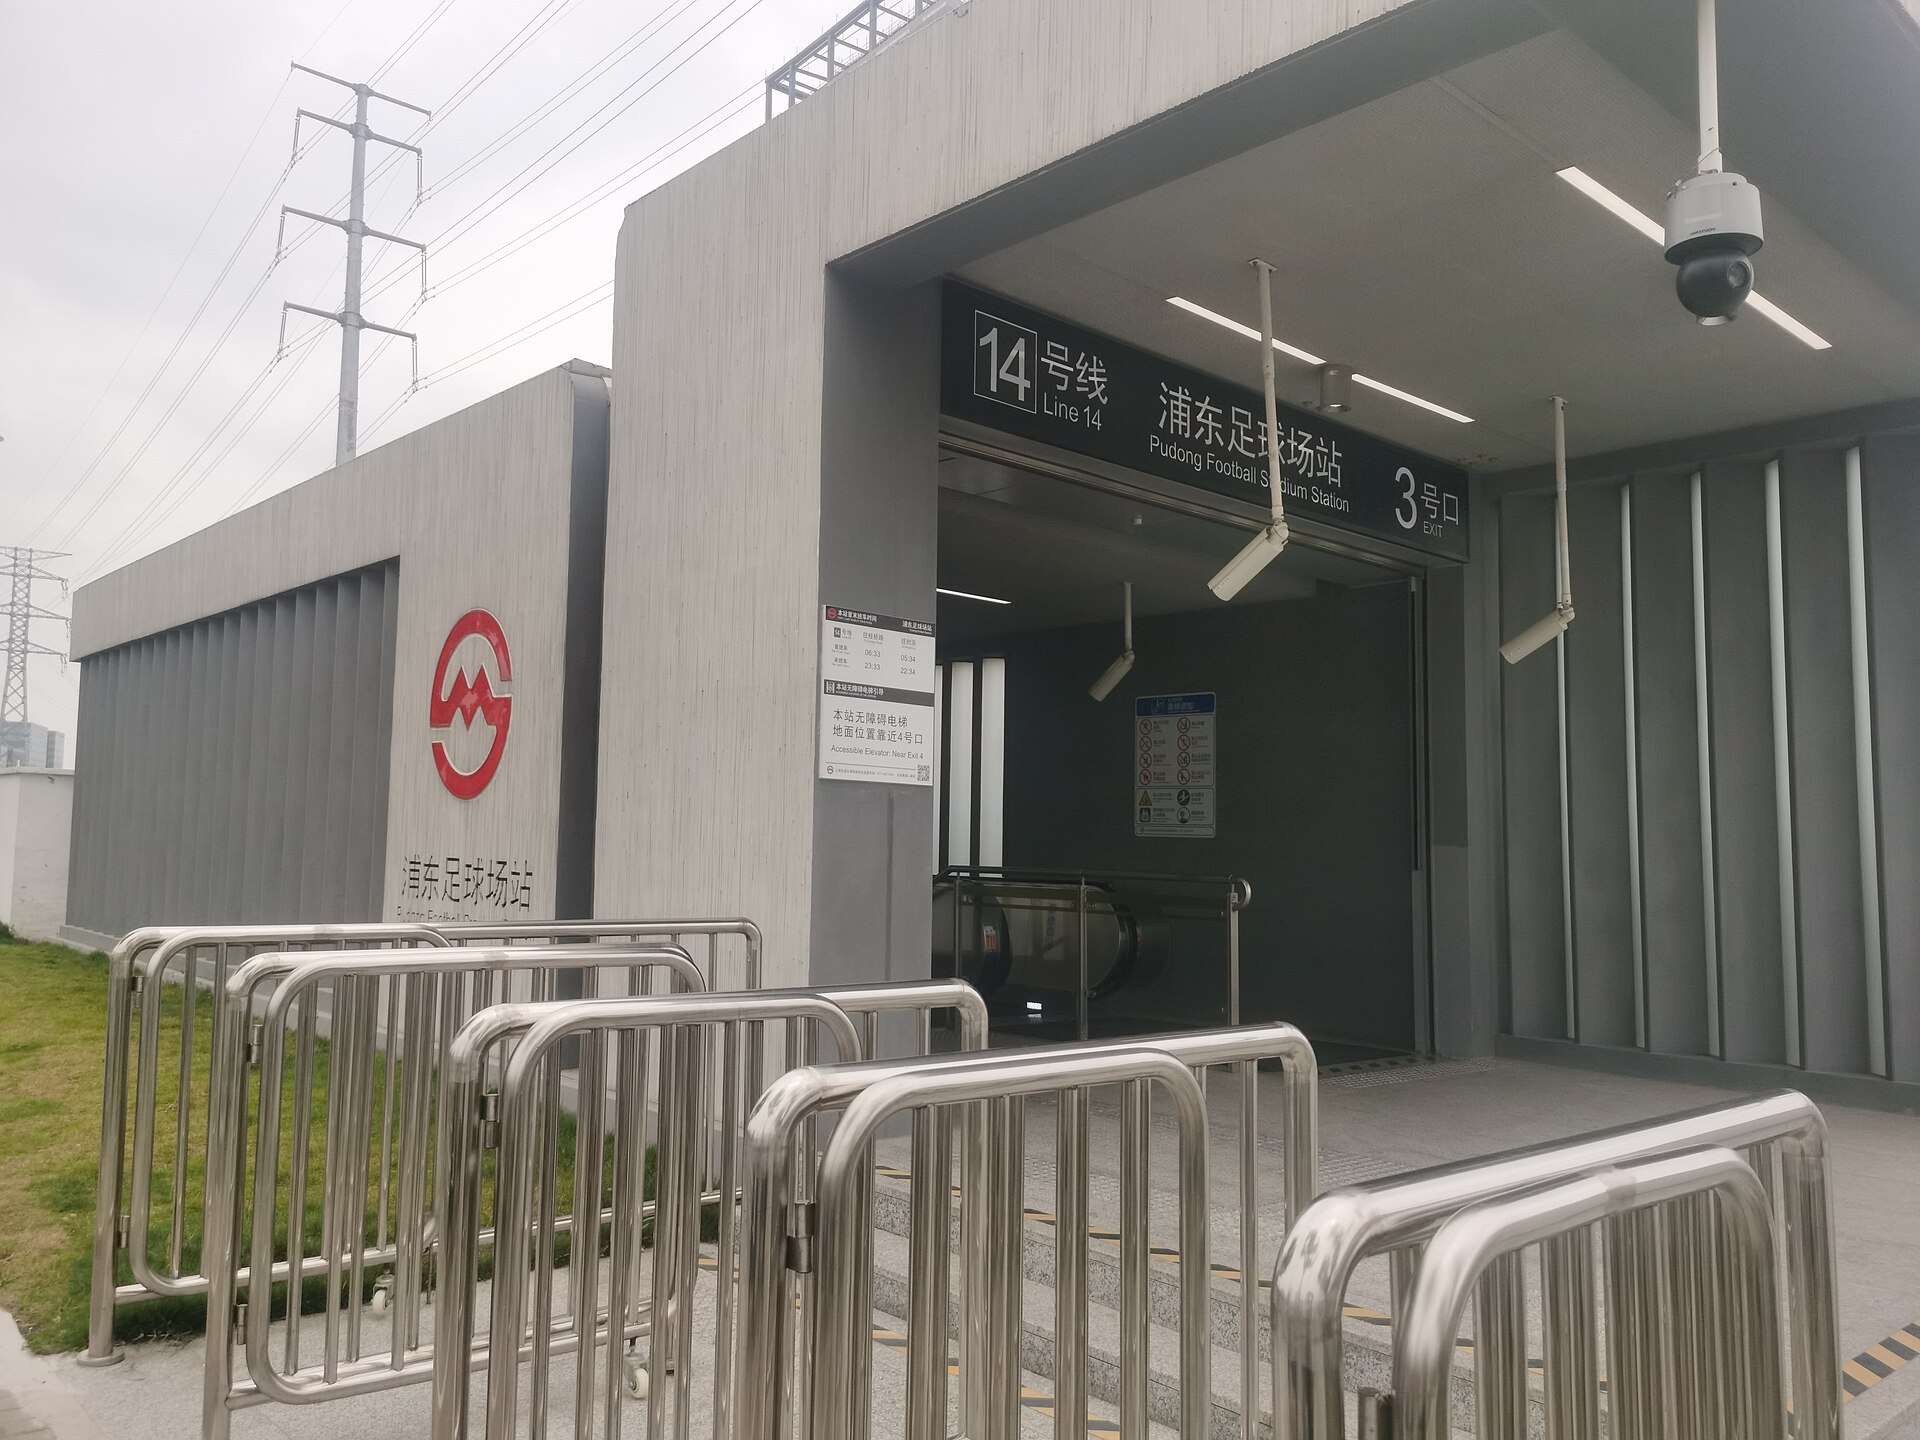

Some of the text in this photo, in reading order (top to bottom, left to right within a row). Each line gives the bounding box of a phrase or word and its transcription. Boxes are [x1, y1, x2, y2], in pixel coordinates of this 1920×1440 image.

[979, 327, 1108, 405] 14 号线
[1043, 392, 1102, 431] Line 14
[1158, 381, 1342, 488] 浦东足球场站
[1149, 433, 1350, 513] Pudong Football Sdium Station
[1423, 520, 1444, 538] EXIT
[864, 649, 881, 657] 06:33
[900, 654, 916, 662] 05:34
[864, 662, 881, 670] 23:33
[900, 667, 916, 675] 22:34
[833, 708, 908, 728] 本站无障碍电梯
[832, 724, 923, 745] 地面位置靠近4号口
[831, 744, 864, 755] Accessible
[864, 747, 891, 757] Elevator:
[892, 750, 906, 758] Near
[907, 751, 919, 759] Exit
[401, 854, 533, 912] 浦东足球场站
